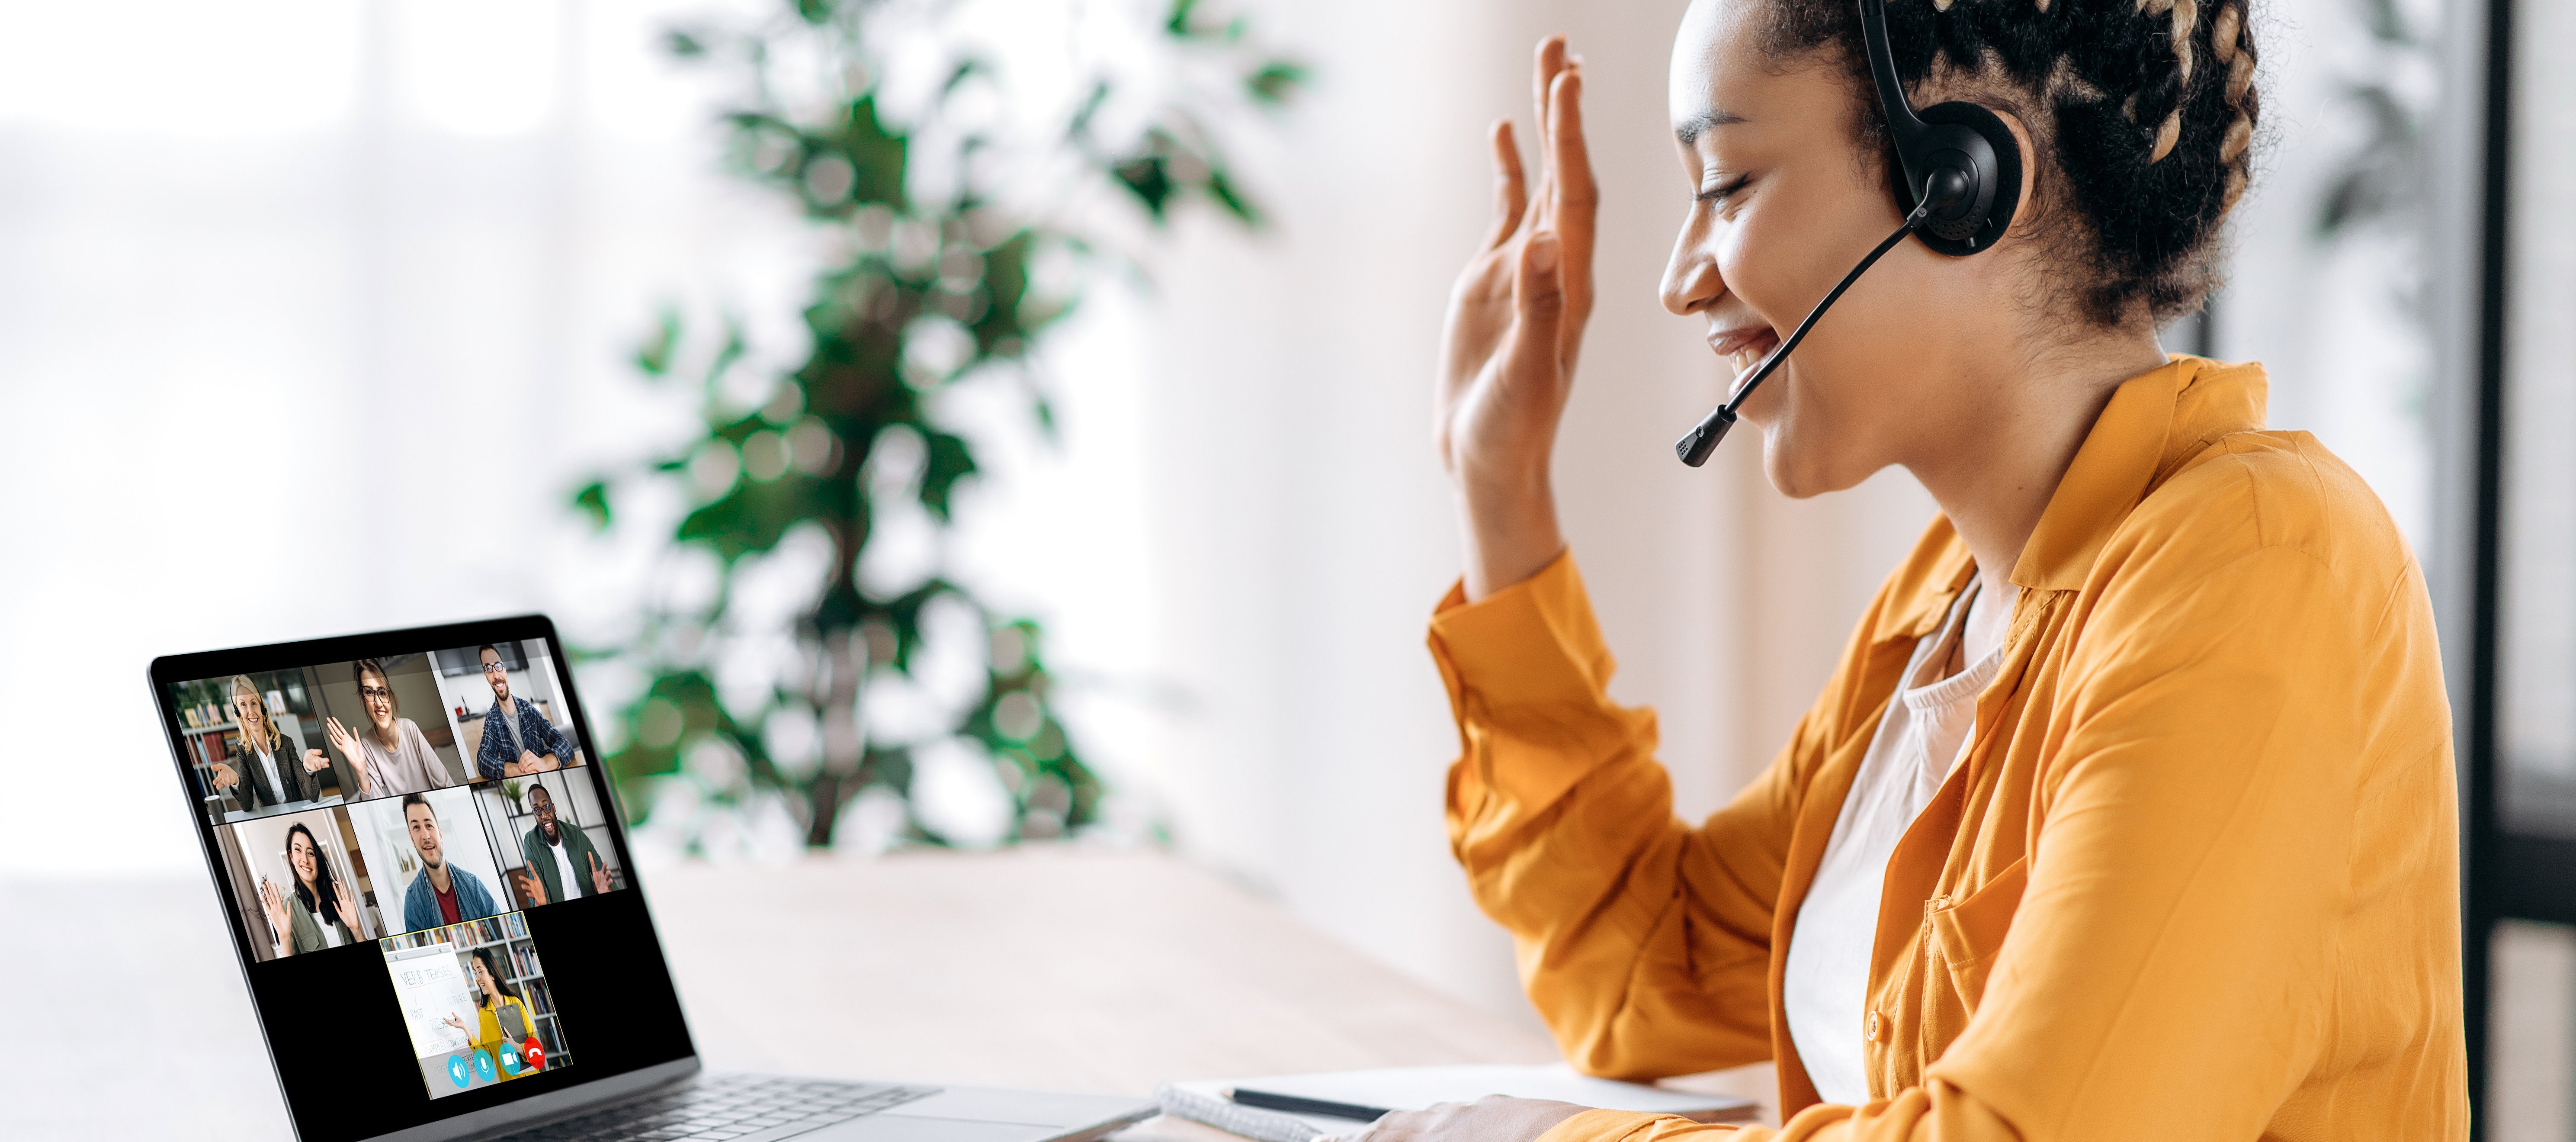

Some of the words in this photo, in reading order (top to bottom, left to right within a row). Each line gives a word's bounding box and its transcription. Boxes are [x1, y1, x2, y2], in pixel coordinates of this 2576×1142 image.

[400, 970, 423, 986] VERB
[423, 965, 452, 981] TENSES
[447, 993, 468, 1007] FUTURE
[410, 1008, 424, 1020] PAST
[425, 1041, 445, 1055] SIMPLE
